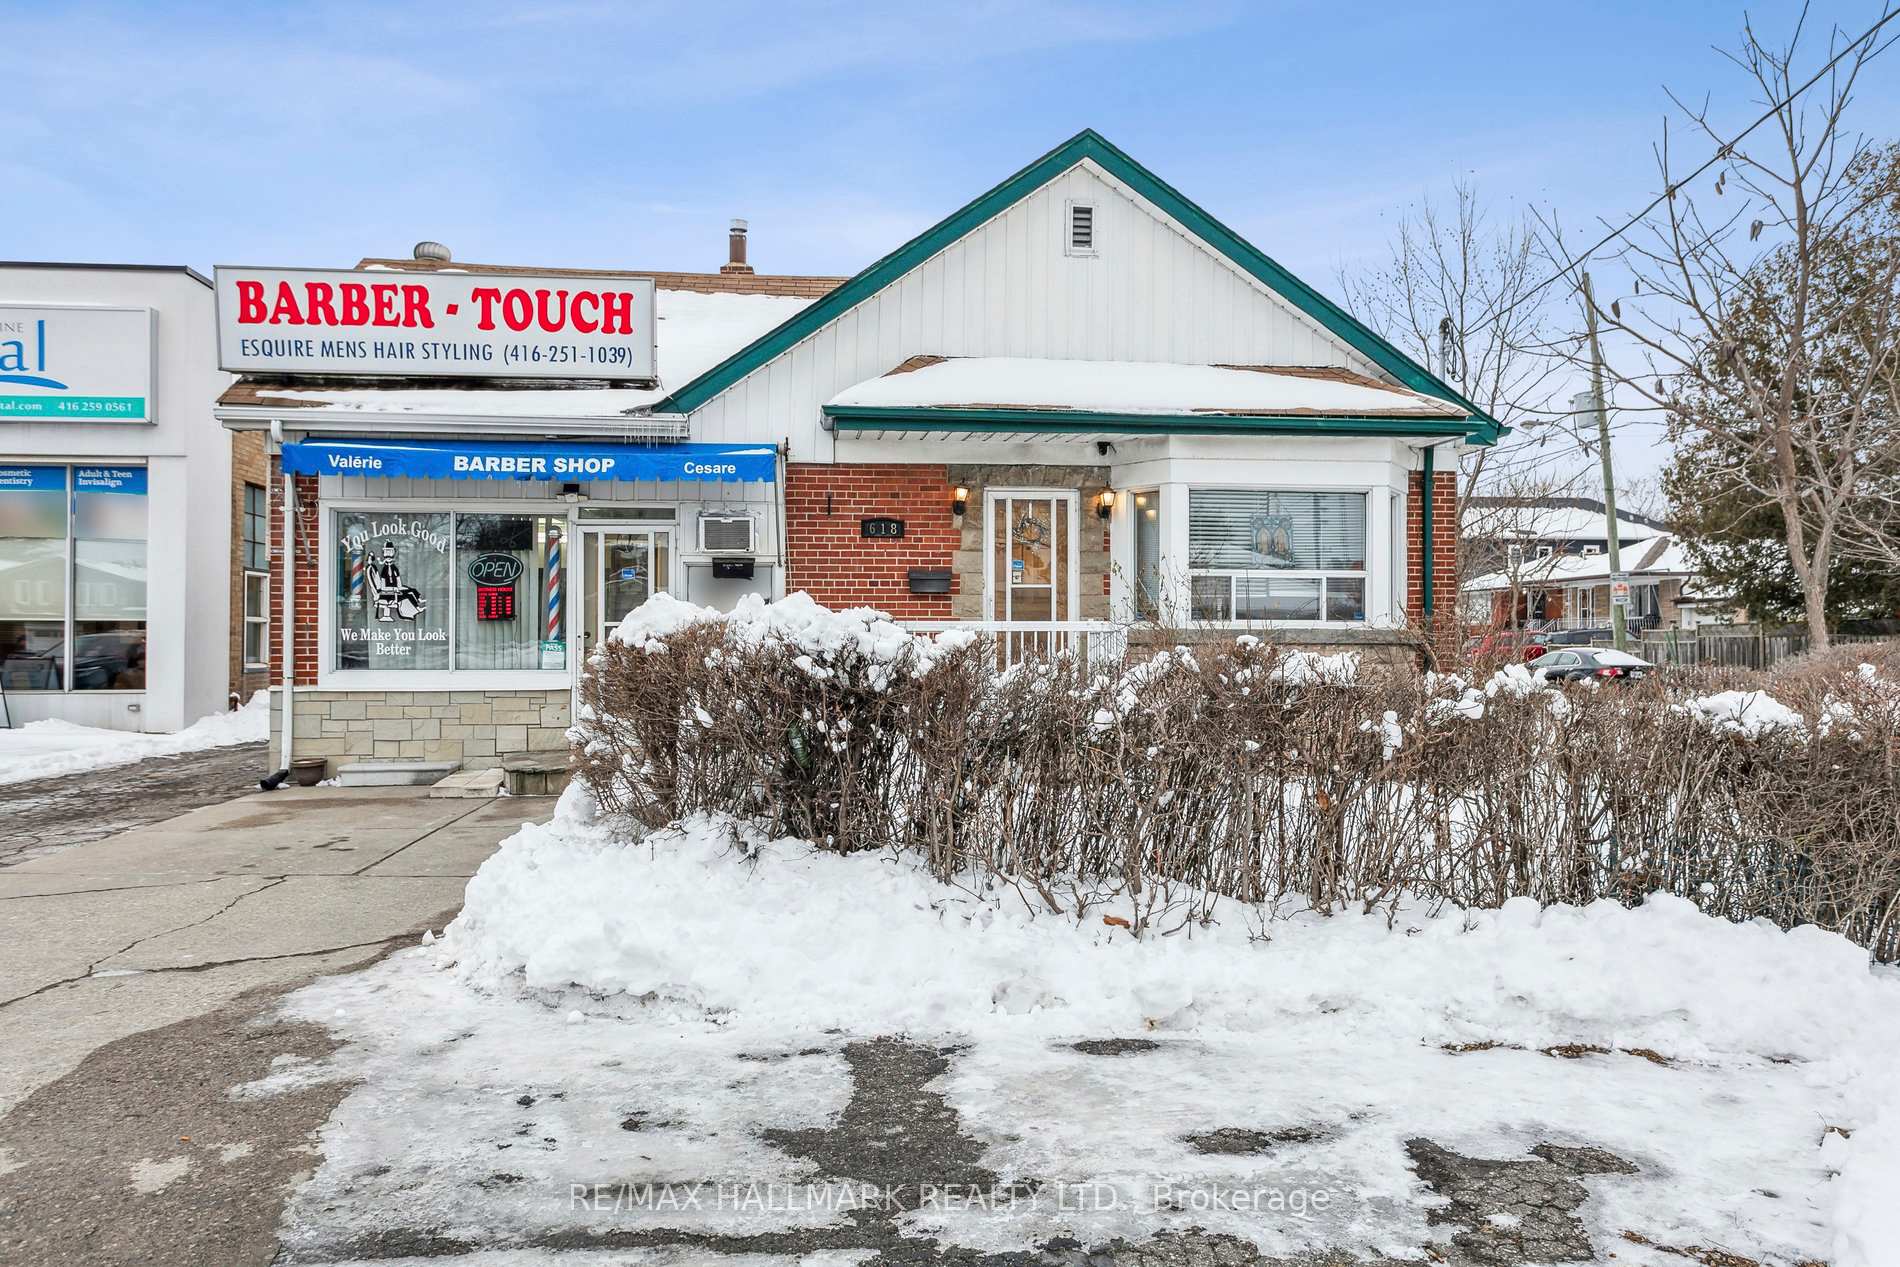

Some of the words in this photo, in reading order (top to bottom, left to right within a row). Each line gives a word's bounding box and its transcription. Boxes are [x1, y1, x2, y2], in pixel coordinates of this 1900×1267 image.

[236, 280, 435, 329] BARBER
[471, 287, 634, 335] TOUCH
[241, 338, 314, 358] ESQUIRE
[321, 340, 367, 359] MENS
[374, 341, 415, 361] HAIR
[422, 342, 493, 362] STYLING
[503, 344, 633, 368] (416-251-1039)
[58, 401, 80, 411] 416
[82, 402, 102, 412] 259
[105, 403, 132, 412] 0561
[328, 454, 383, 470] Valérie
[453, 455, 546, 473] BARBER
[553, 458, 615, 474] SHOP
[684, 461, 737, 476] Cesare
[112, 470, 133, 478] Teen
[78, 478, 123, 488] Invisalign
[869, 523, 897, 534] 618
[341, 530, 369, 553] You
[371, 518, 407, 538] Look
[411, 521, 447, 554] Good
[472, 561, 517, 578] OPEN
[340, 629, 358, 640] We
[360, 628, 391, 640] Make
[393, 629, 415, 640] You
[417, 628, 446, 640] Look
[376, 642, 412, 656] Better
